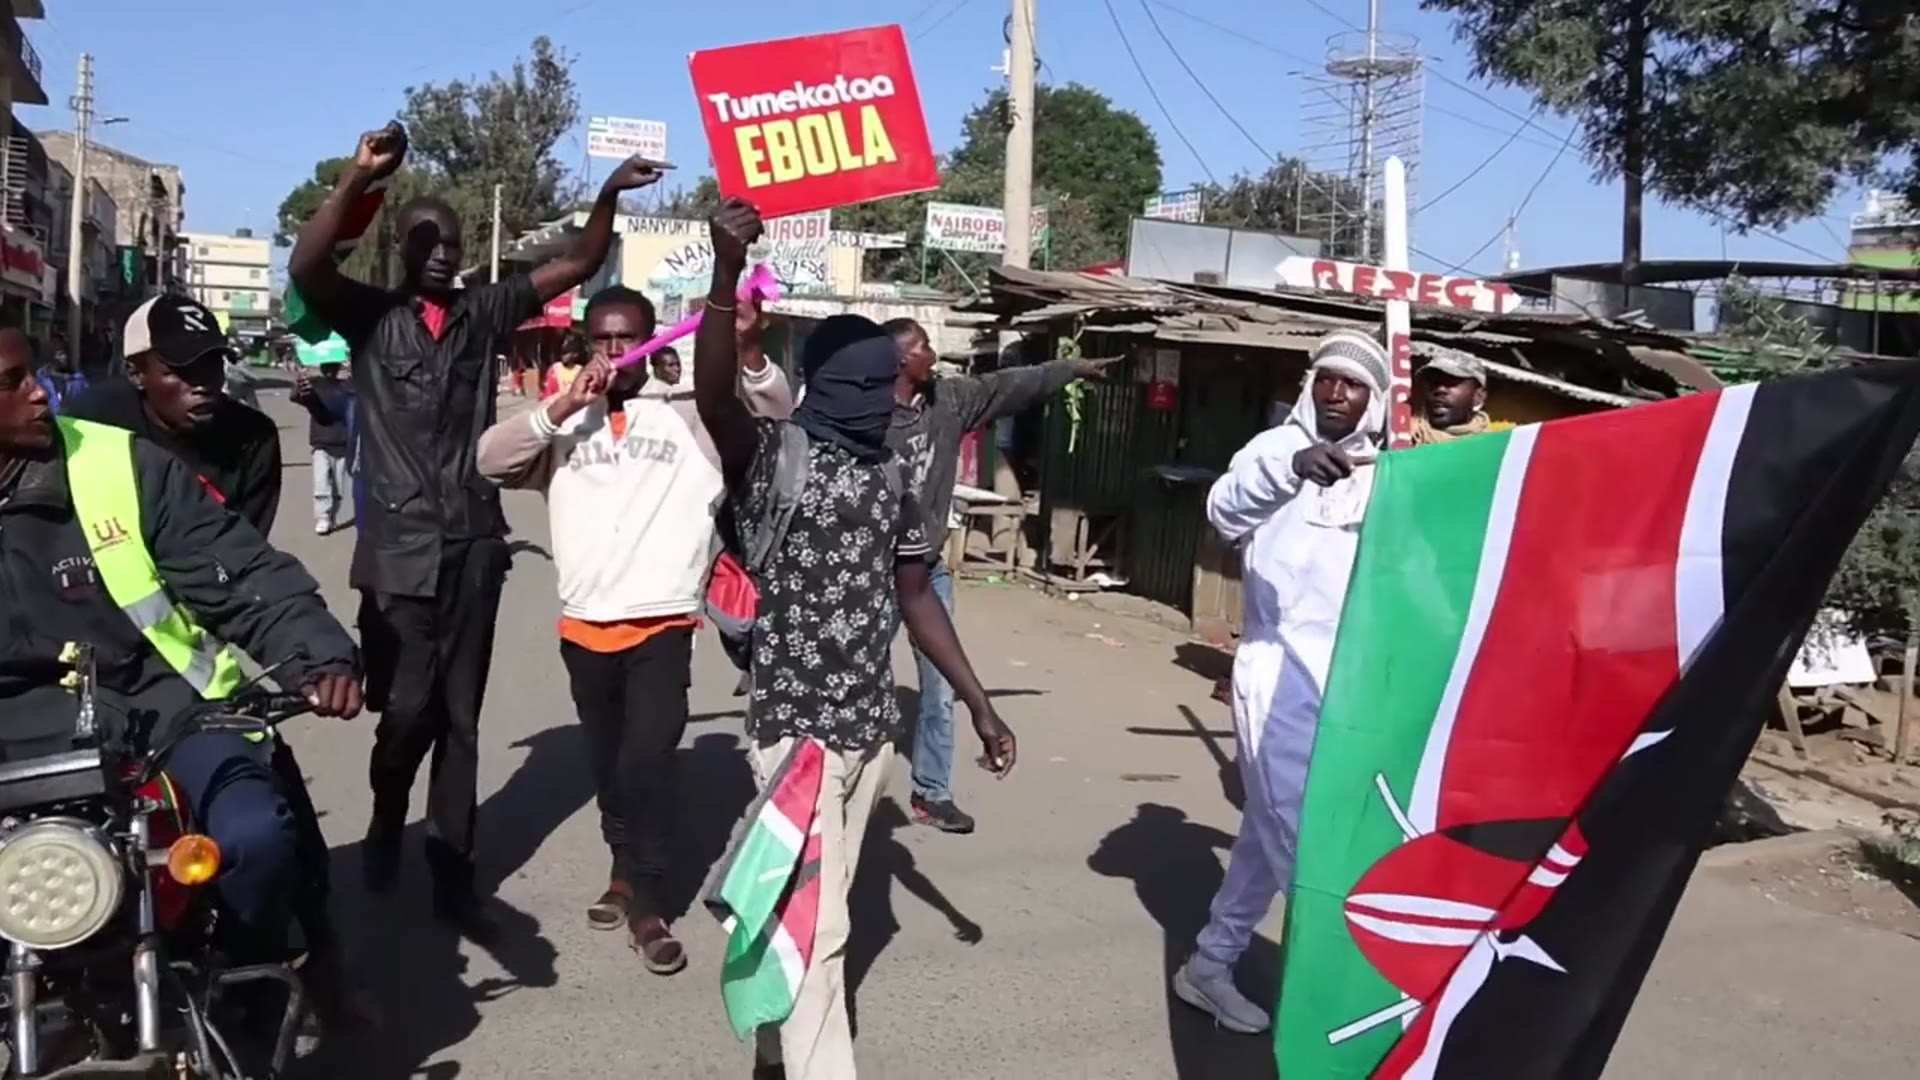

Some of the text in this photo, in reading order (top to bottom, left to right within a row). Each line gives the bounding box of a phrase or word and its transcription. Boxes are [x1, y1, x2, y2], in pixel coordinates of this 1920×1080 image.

[708, 74, 895, 123] Tumekataa
[734, 104, 897, 188] EBOLA
[627, 218, 690, 235] NANYUKI
[931, 213, 1003, 232] NAIROBI
